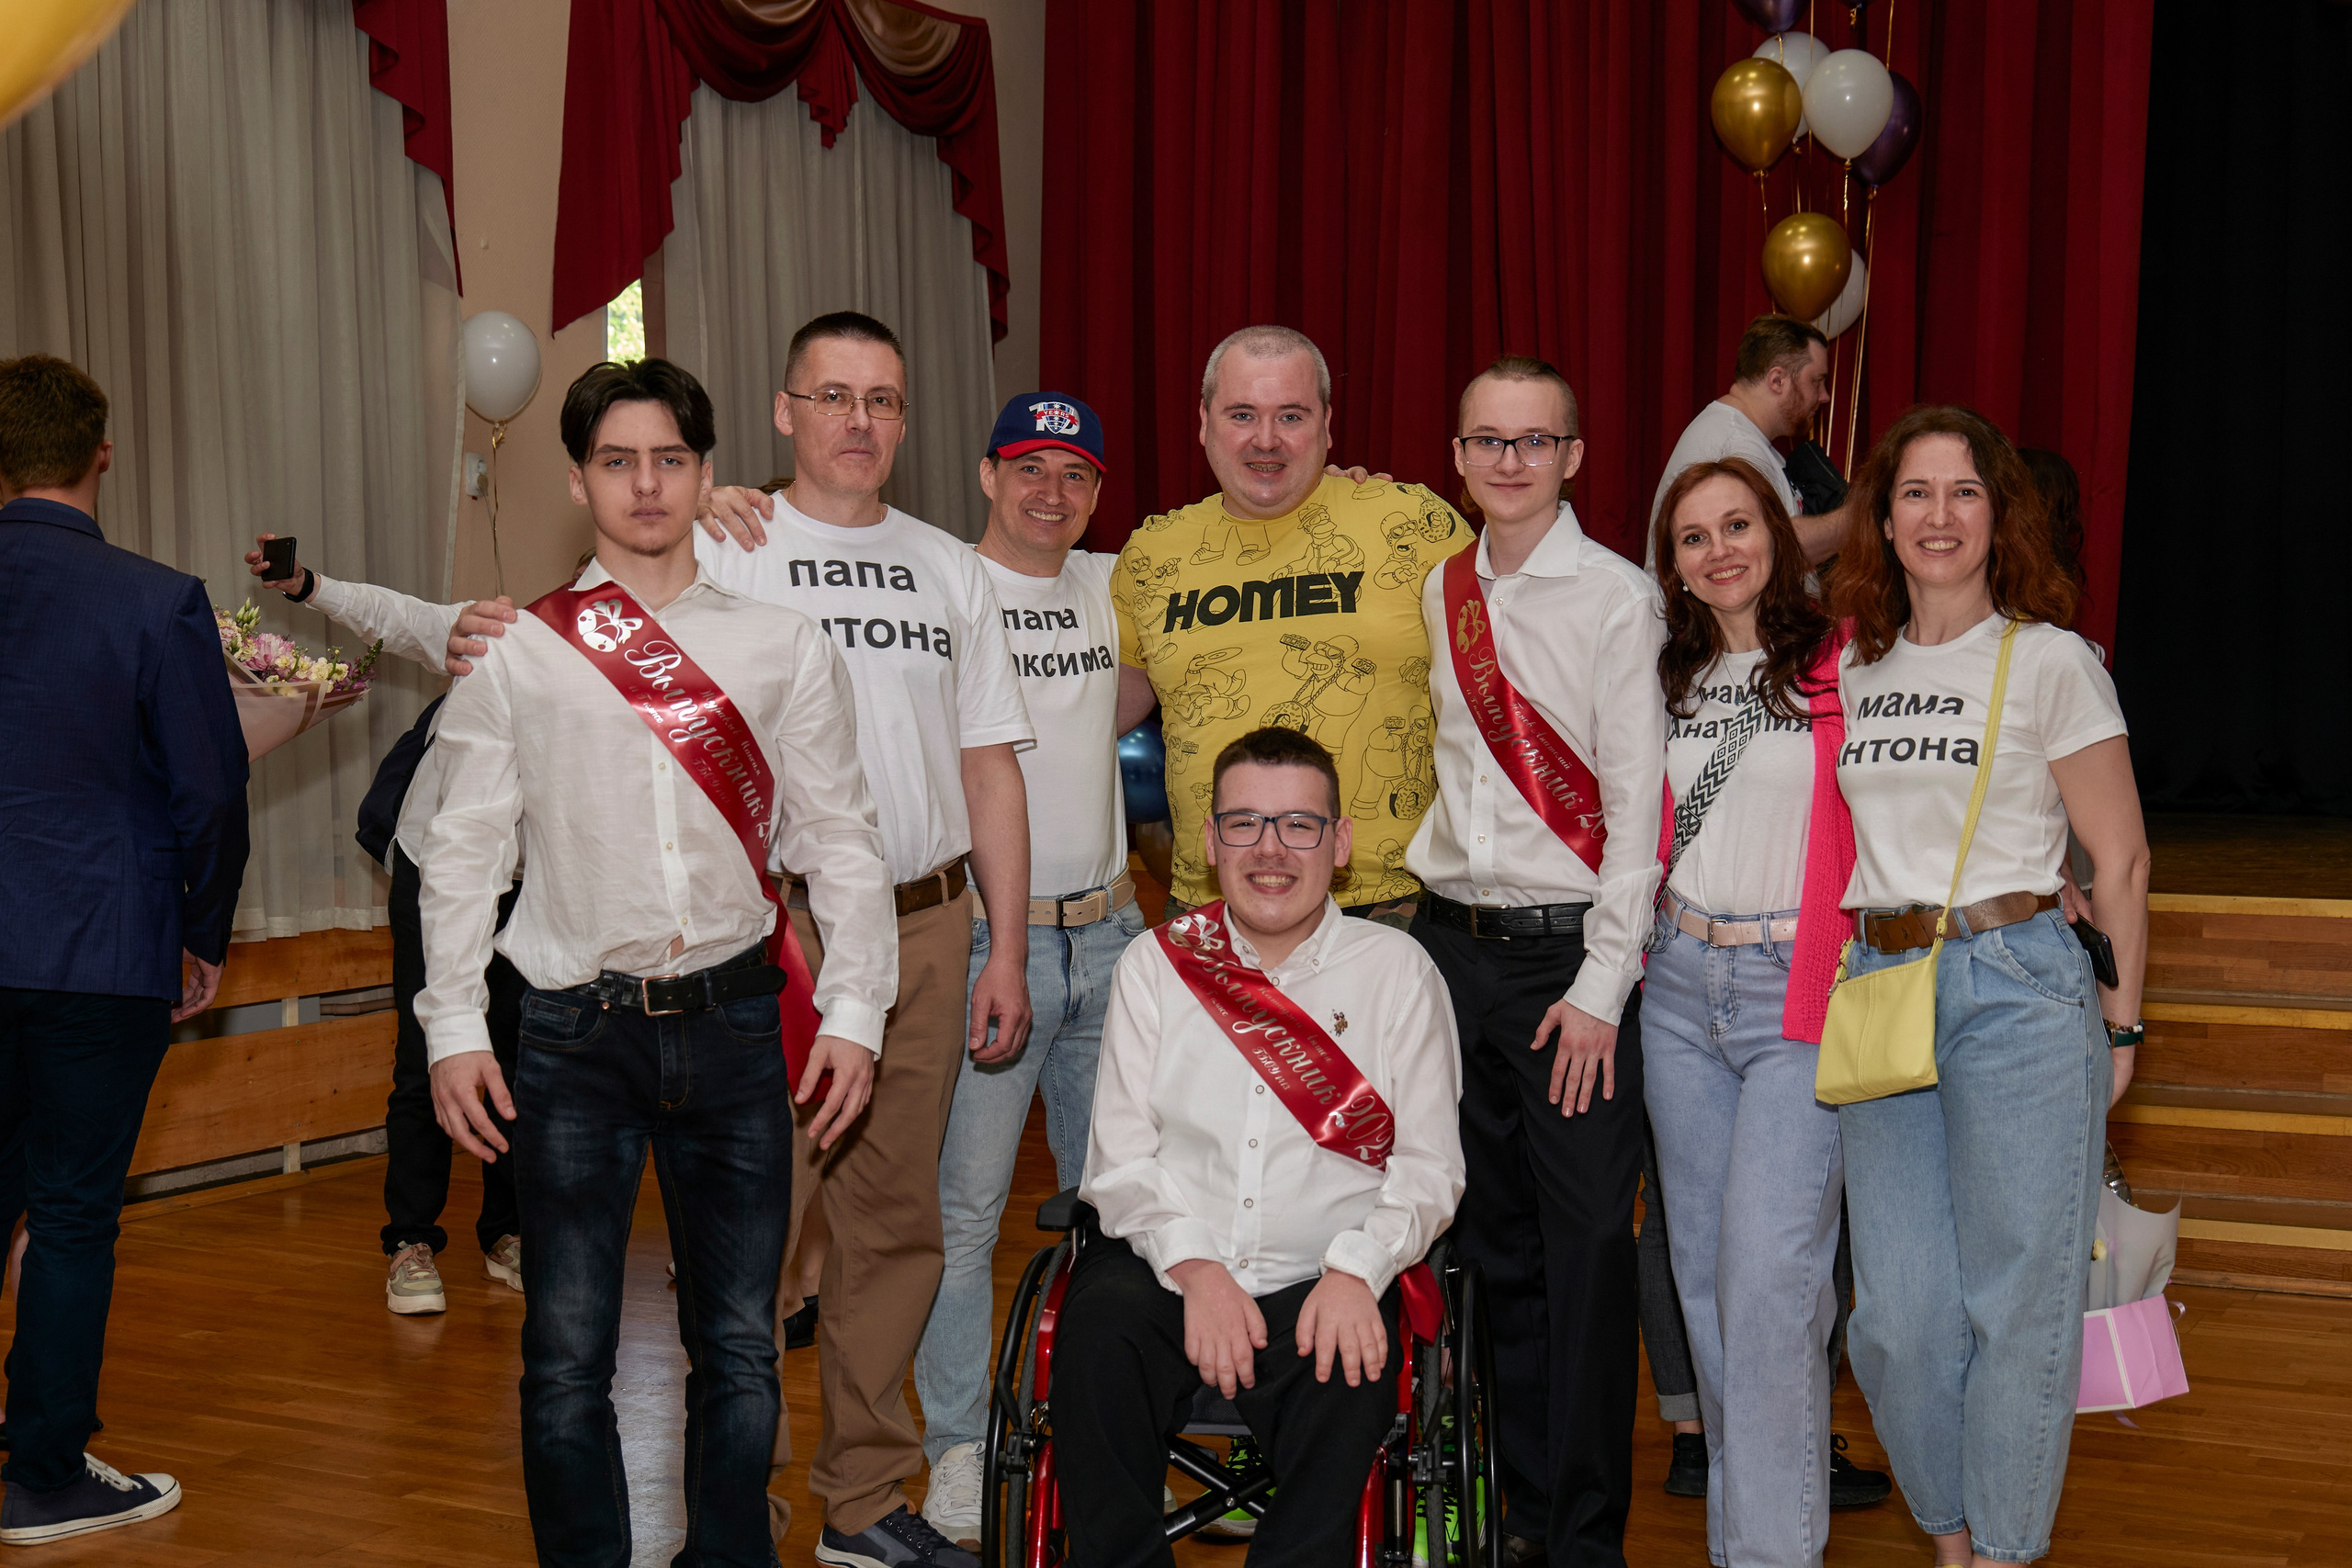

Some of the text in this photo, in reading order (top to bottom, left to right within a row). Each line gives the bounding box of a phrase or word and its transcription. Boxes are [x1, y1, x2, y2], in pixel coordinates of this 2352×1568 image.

[788, 559, 918, 592] папа
[1001, 608, 1079, 631] папа
[1162, 571, 1364, 634] HOMEY
[821, 617, 952, 661] тона
[1010, 646, 1114, 677] ксима
[1857, 692, 1965, 720] мама
[624, 639, 764, 818] Выпускник
[1468, 646, 1584, 810] Выпускник
[691, 757, 720, 787] ГБОУ
[1251, 1046, 1292, 1091] ГБОУ 1413
